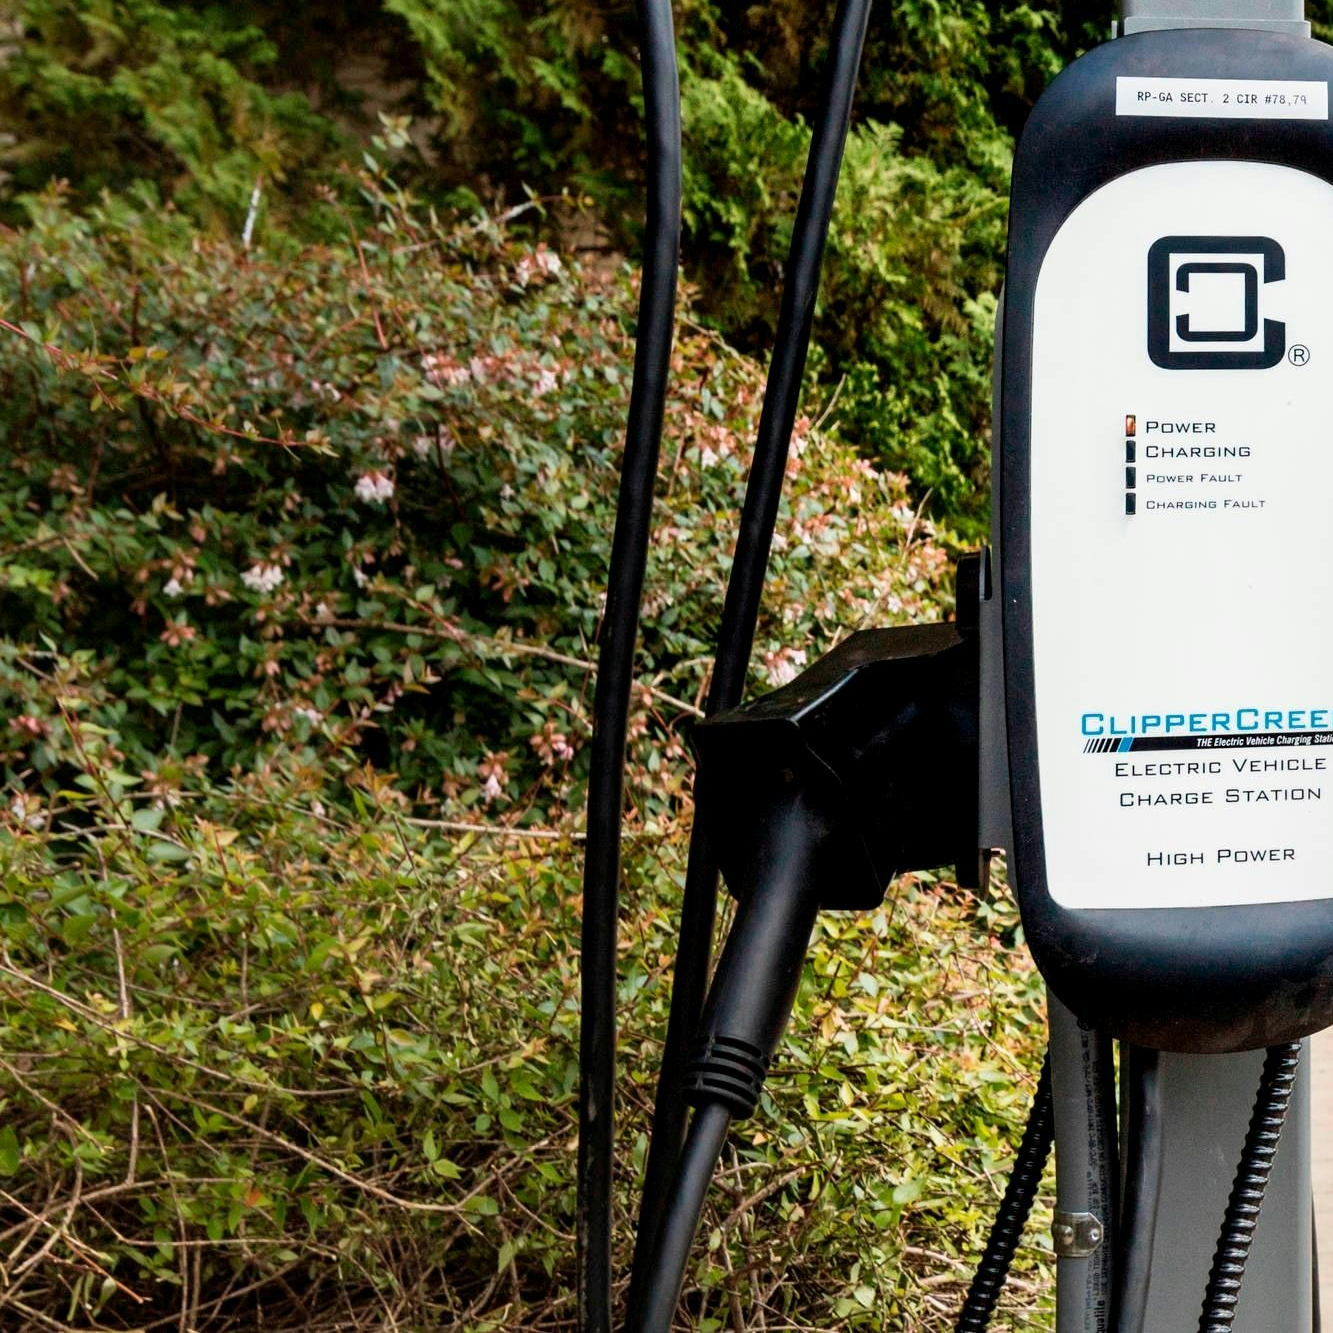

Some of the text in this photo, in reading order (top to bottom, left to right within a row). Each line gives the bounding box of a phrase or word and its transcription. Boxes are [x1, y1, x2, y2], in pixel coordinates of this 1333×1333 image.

[1137, 91, 1307, 106] RP-GA SECT. 2 CIR #78,79
[1146, 421, 1216, 434] POWER
[1146, 445, 1251, 458] CHARGING
[1146, 473, 1243, 483] POWER FAULT
[1146, 499, 1266, 510] CHARGING FAULT
[1196, 737, 1213, 747] THE
[1213, 736, 1244, 747] Electric
[1245, 735, 1275, 746] Vehicle
[1276, 734, 1312, 746] Charging
[1115, 757, 1327, 777] ELECTRIC VEHICLE
[1119, 787, 1321, 807] CHARGE STATION
[1147, 848, 1296, 866] HIGH POWER
